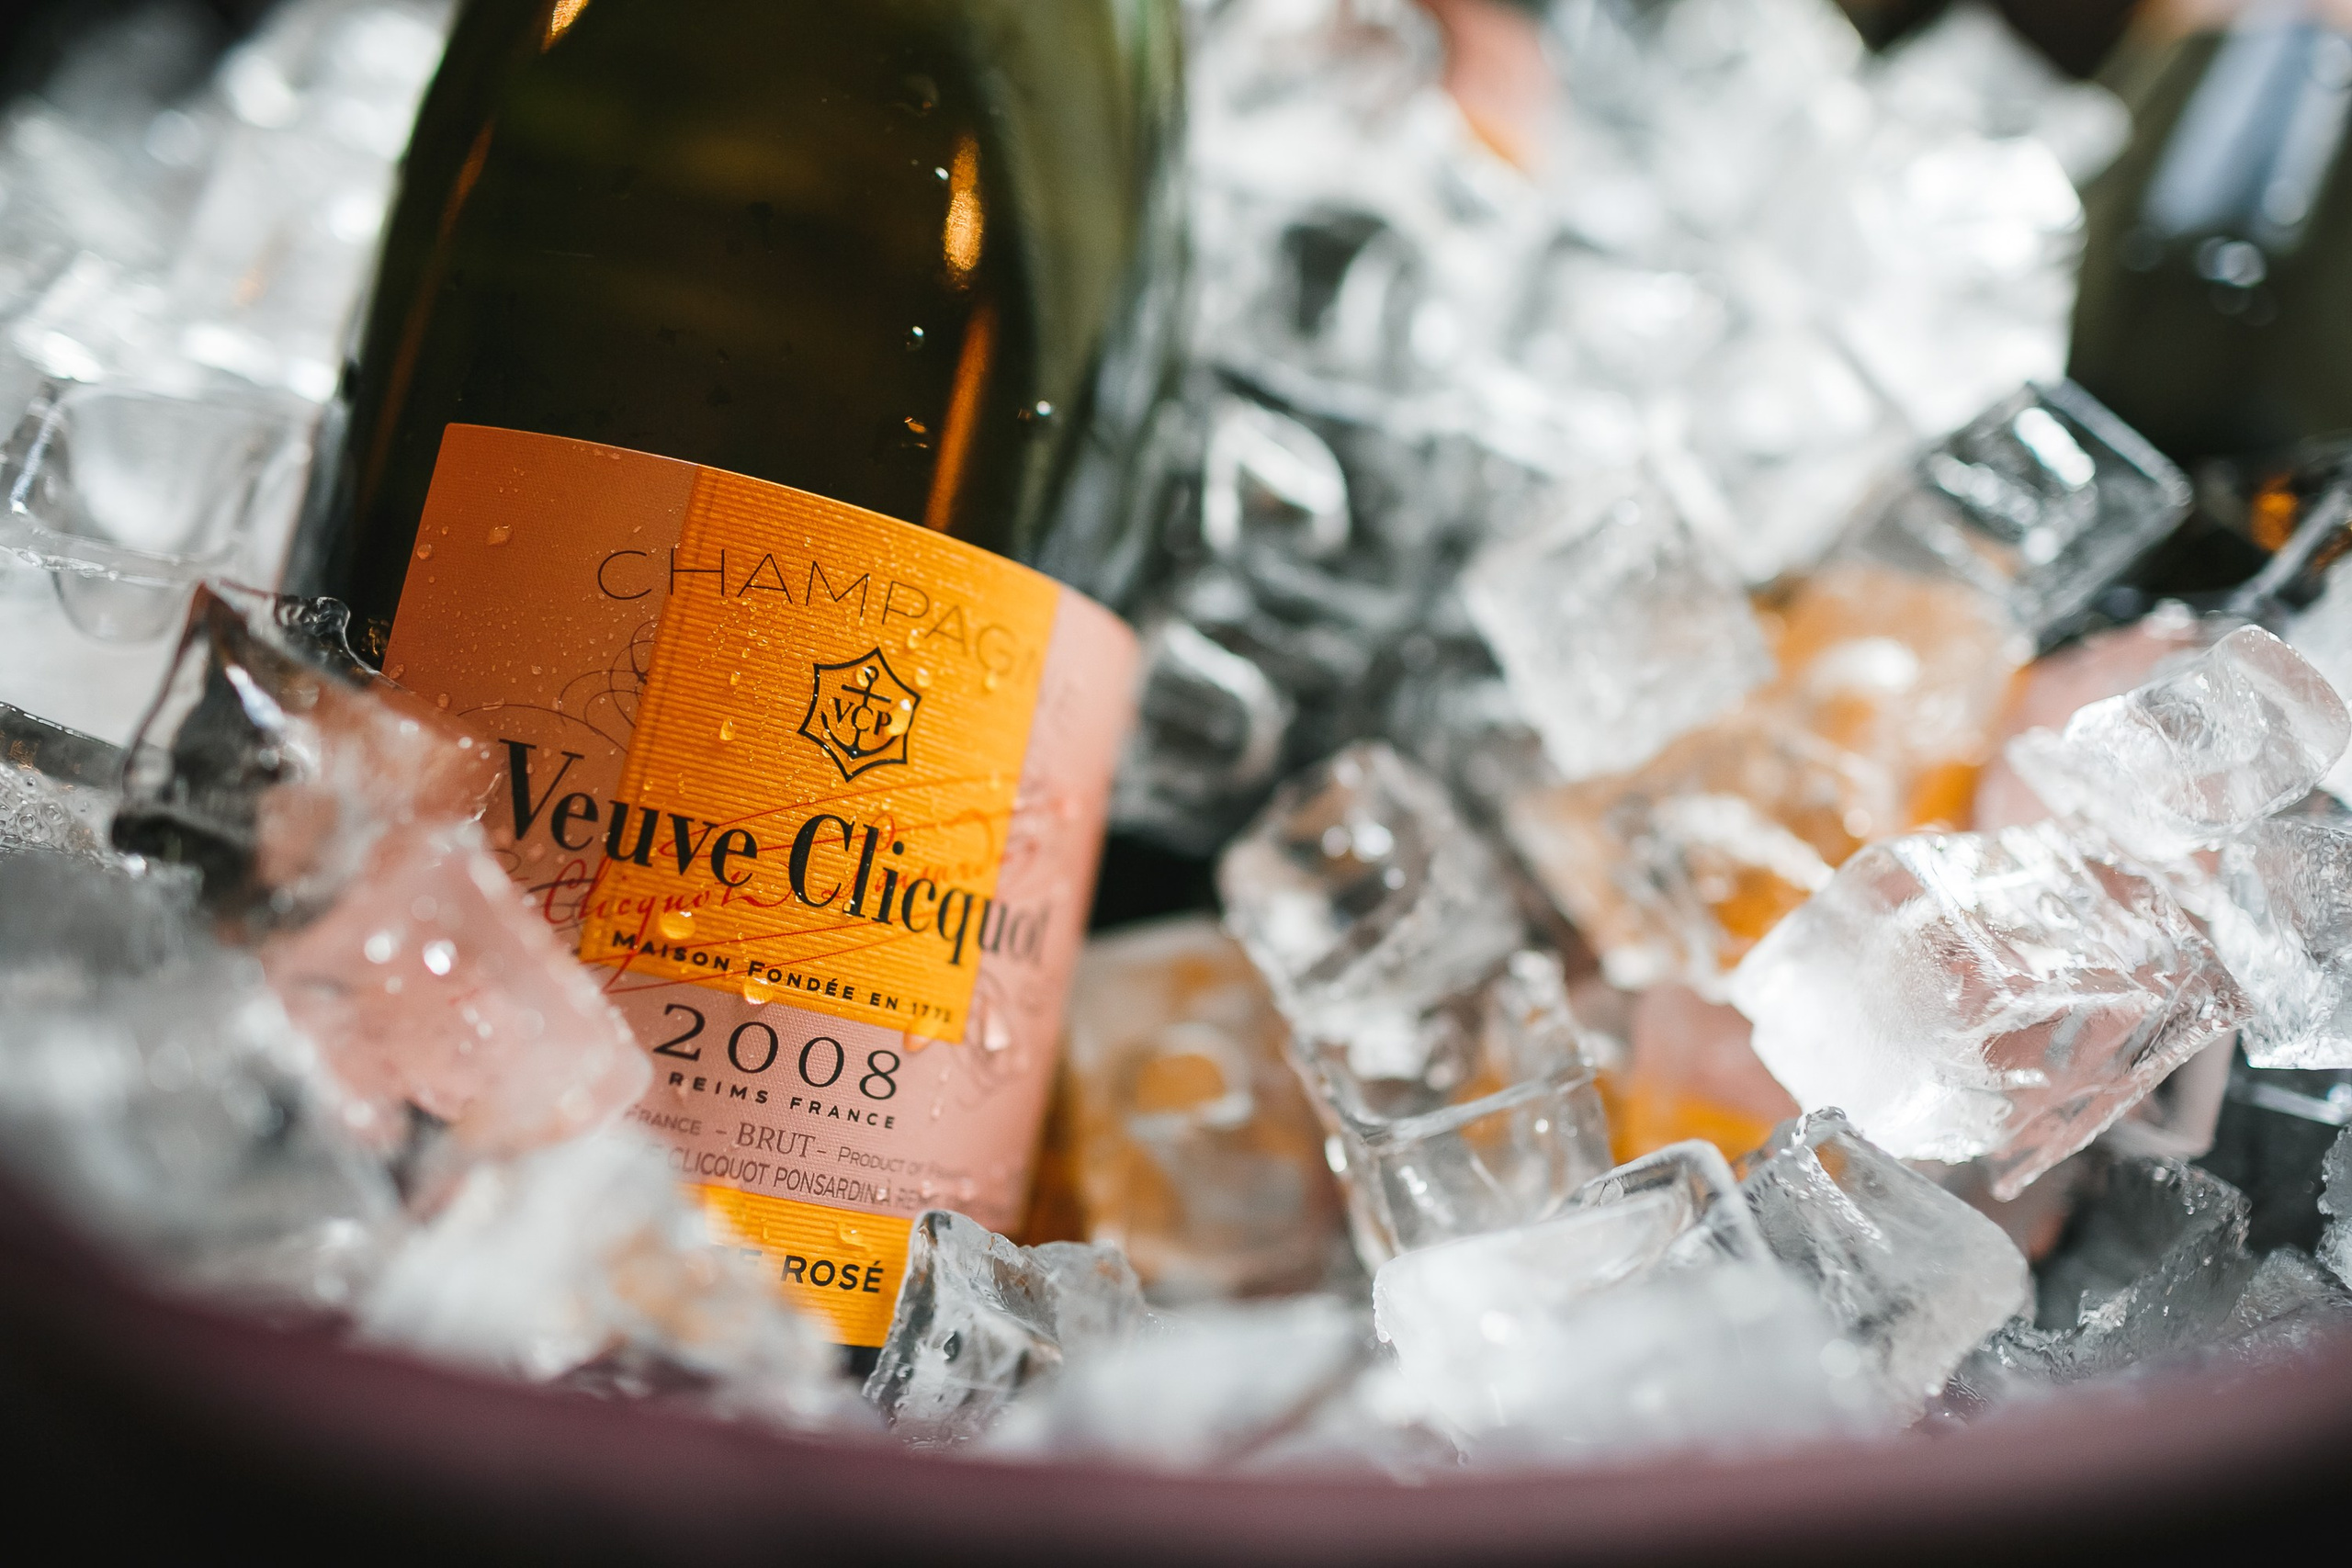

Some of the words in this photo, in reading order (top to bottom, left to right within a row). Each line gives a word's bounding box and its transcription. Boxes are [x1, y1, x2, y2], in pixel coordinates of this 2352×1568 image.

[832, 696, 892, 736] VCP
[500, 739, 758, 886] Veuve
[612, 931, 730, 972] MAISON
[747, 960, 855, 1000] FONDÉE
[869, 992, 899, 1010] EN
[652, 1003, 901, 1100] 2008
[668, 1071, 769, 1104] REIMS
[789, 1096, 897, 1130] FRANCE
[774, 1166, 879, 1204] PONSARDIN
[780, 1254, 884, 1293] ROSÉ
